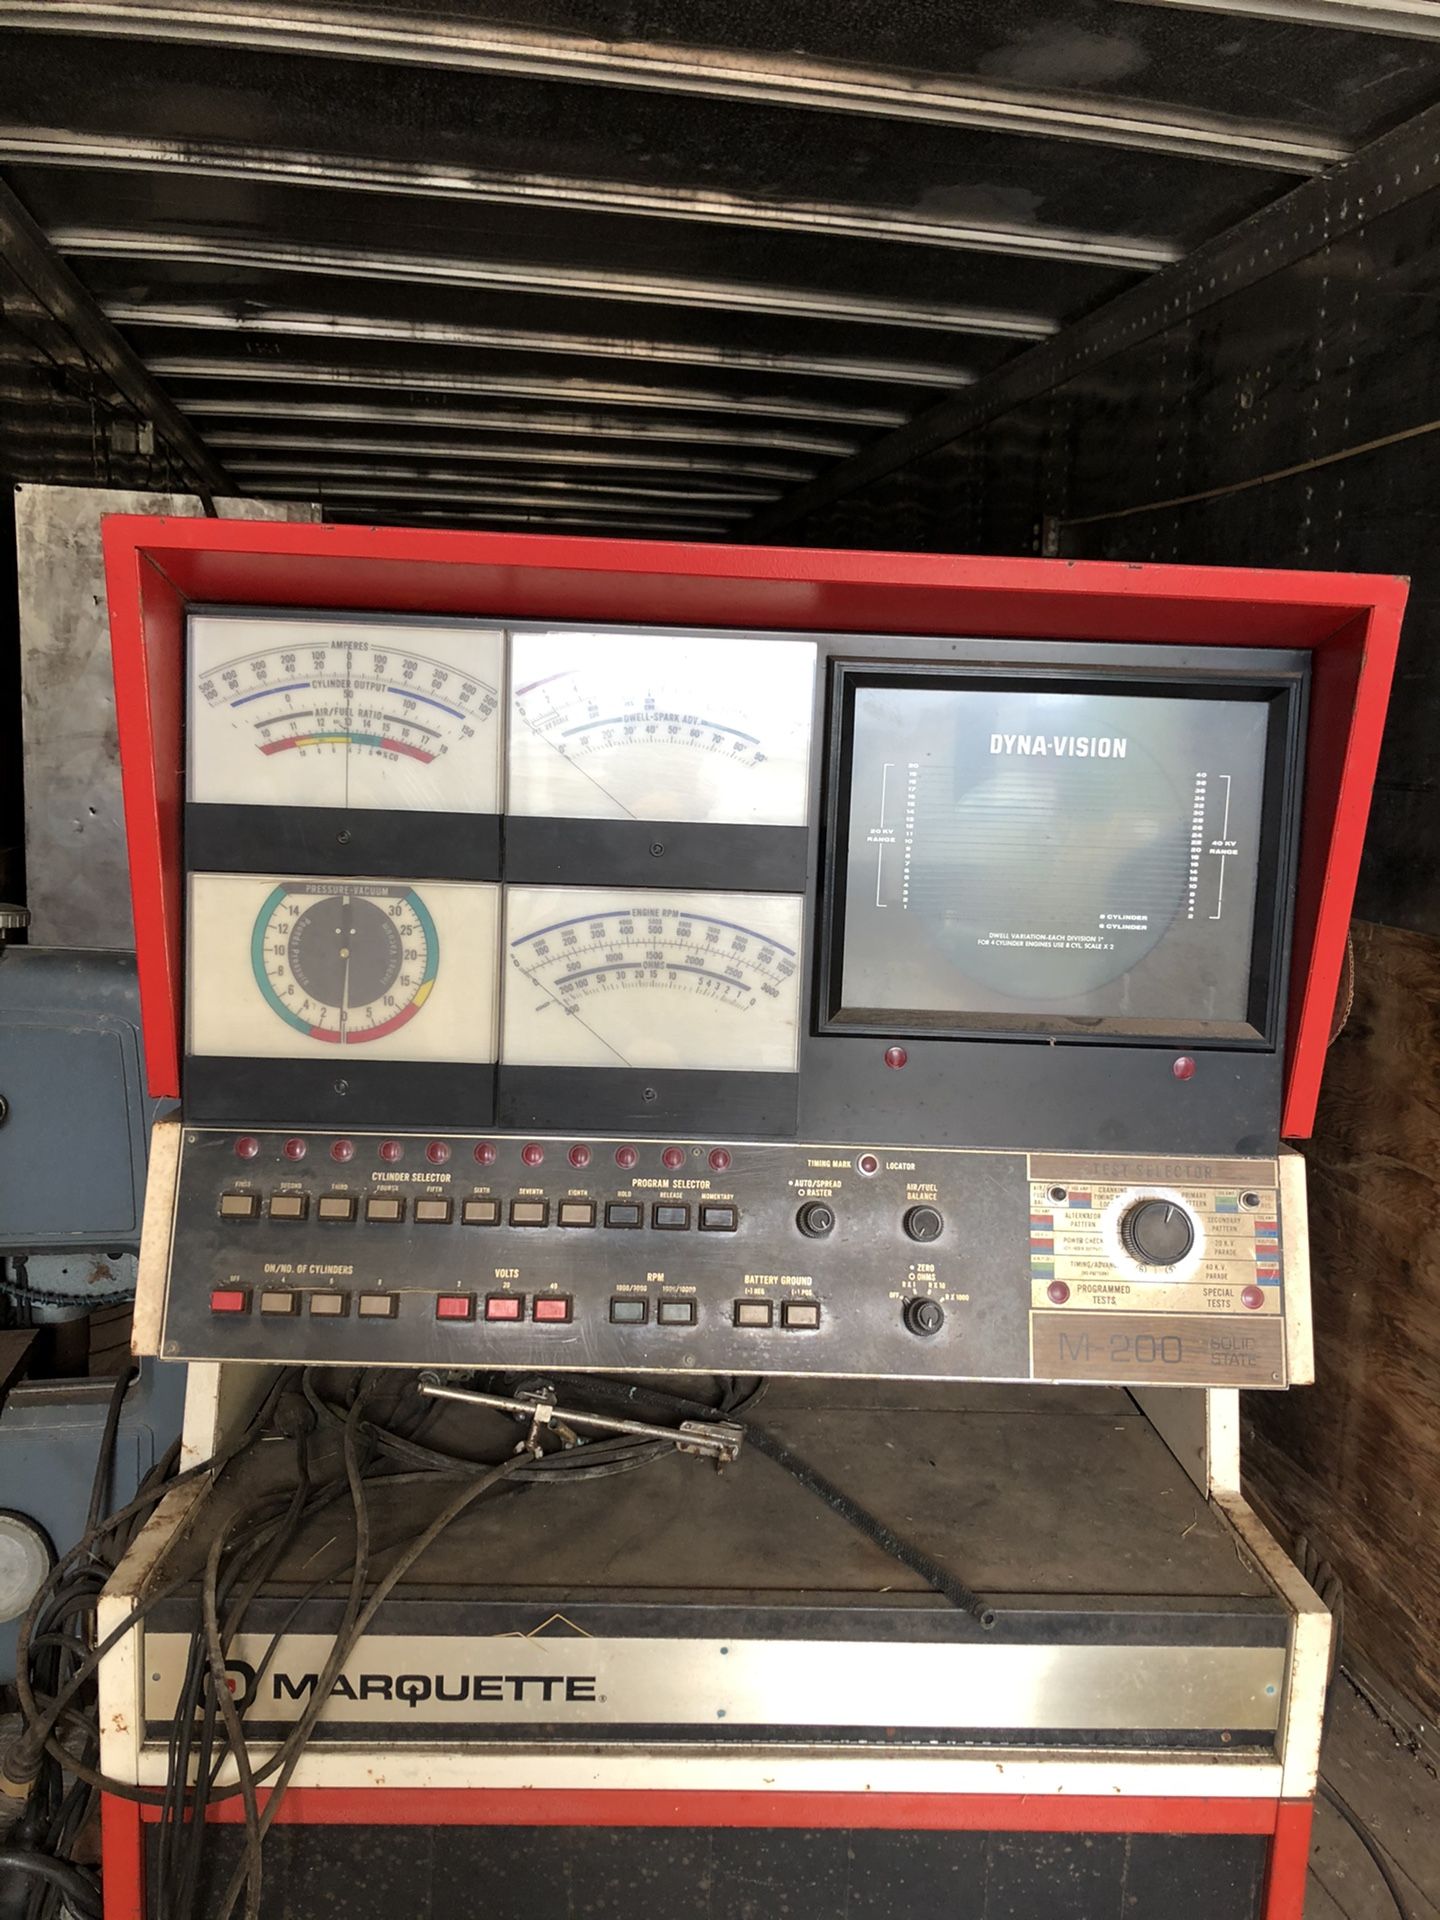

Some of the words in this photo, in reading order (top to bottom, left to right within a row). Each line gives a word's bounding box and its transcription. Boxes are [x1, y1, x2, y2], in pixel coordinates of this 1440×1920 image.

[331, 641, 369, 651] AMPERES
[312, 651, 326, 660] 100
[374, 655, 387, 665] 100
[312, 680, 351, 690] CYLINDER
[354, 681, 386, 692] OUTPUT
[403, 700, 416, 710] 100
[315, 707, 353, 717] AIR/FUEL
[358, 708, 382, 720] RATIO
[623, 713, 680, 723] DWELL-SPARK
[990, 733, 1127, 758] DYNA-VISION
[306, 884, 389, 896] PRESSURE-VACUUM
[289, 905, 299, 916] 14
[388, 905, 401, 916] 30
[632, 909, 659, 917] ENGINE
[662, 909, 679, 918] RPM
[278, 923, 288, 934] 12
[400, 925, 412, 936] 25
[562, 936, 577, 947] 200
[590, 930, 605, 940] 300
[619, 926, 634, 934] 400
[648, 926, 662, 934] 500
[705, 932, 719, 943] 700
[989, 932, 1009, 940] DWELL
[274, 945, 285, 955] 10
[404, 949, 416, 960] 20
[643, 961, 665, 970] OHMS
[566, 961, 581, 972] 500
[606, 953, 623, 962] 1000
[646, 951, 663, 960] 1500
[685, 955, 704, 966] 2000
[724, 966, 743, 979] 2500
[761, 982, 780, 998] 3000
[400, 976, 410, 986] 15
[559, 983, 574, 994] 200
[575, 979, 588, 988] 100
[596, 973, 606, 983] 50
[616, 970, 626, 979] 30
[635, 970, 644, 978] 20
[384, 996, 394, 1006] 10
[832, 1160, 851, 1168] MARK
[886, 1162, 915, 1170] LOCATOR
[1093, 1163, 1127, 1178] TEST
[1136, 1164, 1212, 1179] SELECTOR
[372, 1172, 410, 1182] CYLINDER
[411, 1174, 451, 1183] SELECTOR
[426, 1185, 443, 1193] FIFTH
[632, 1179, 669, 1188] PROGRAM
[672, 1180, 711, 1189] SELECTOR
[794, 1180, 842, 1188] AUTO/SPREAD
[906, 1183, 938, 1192] AIR/FUEL
[806, 1189, 832, 1197] RASTER
[907, 1192, 937, 1200] BALANCE
[264, 1263, 294, 1273] ON/NO.
[296, 1264, 306, 1273] OF
[309, 1265, 354, 1274] CYLINDERS
[917, 1264, 935, 1272] ZERO
[495, 1269, 520, 1279] VOLTS
[647, 1272, 665, 1282] RPM
[917, 1273, 936, 1281] OHMS
[744, 1275, 778, 1284] BATTERY
[780, 1276, 812, 1286] GROUND
[1077, 1284, 1131, 1294] PROGRAMMED
[1203, 1288, 1234, 1296] SPECIAL
[1093, 1296, 1116, 1305] TESTS
[1207, 1300, 1231, 1308] TESTS
[1210, 1353, 1257, 1367] STATE
[273, 1674, 596, 1708] MARQUETTE
